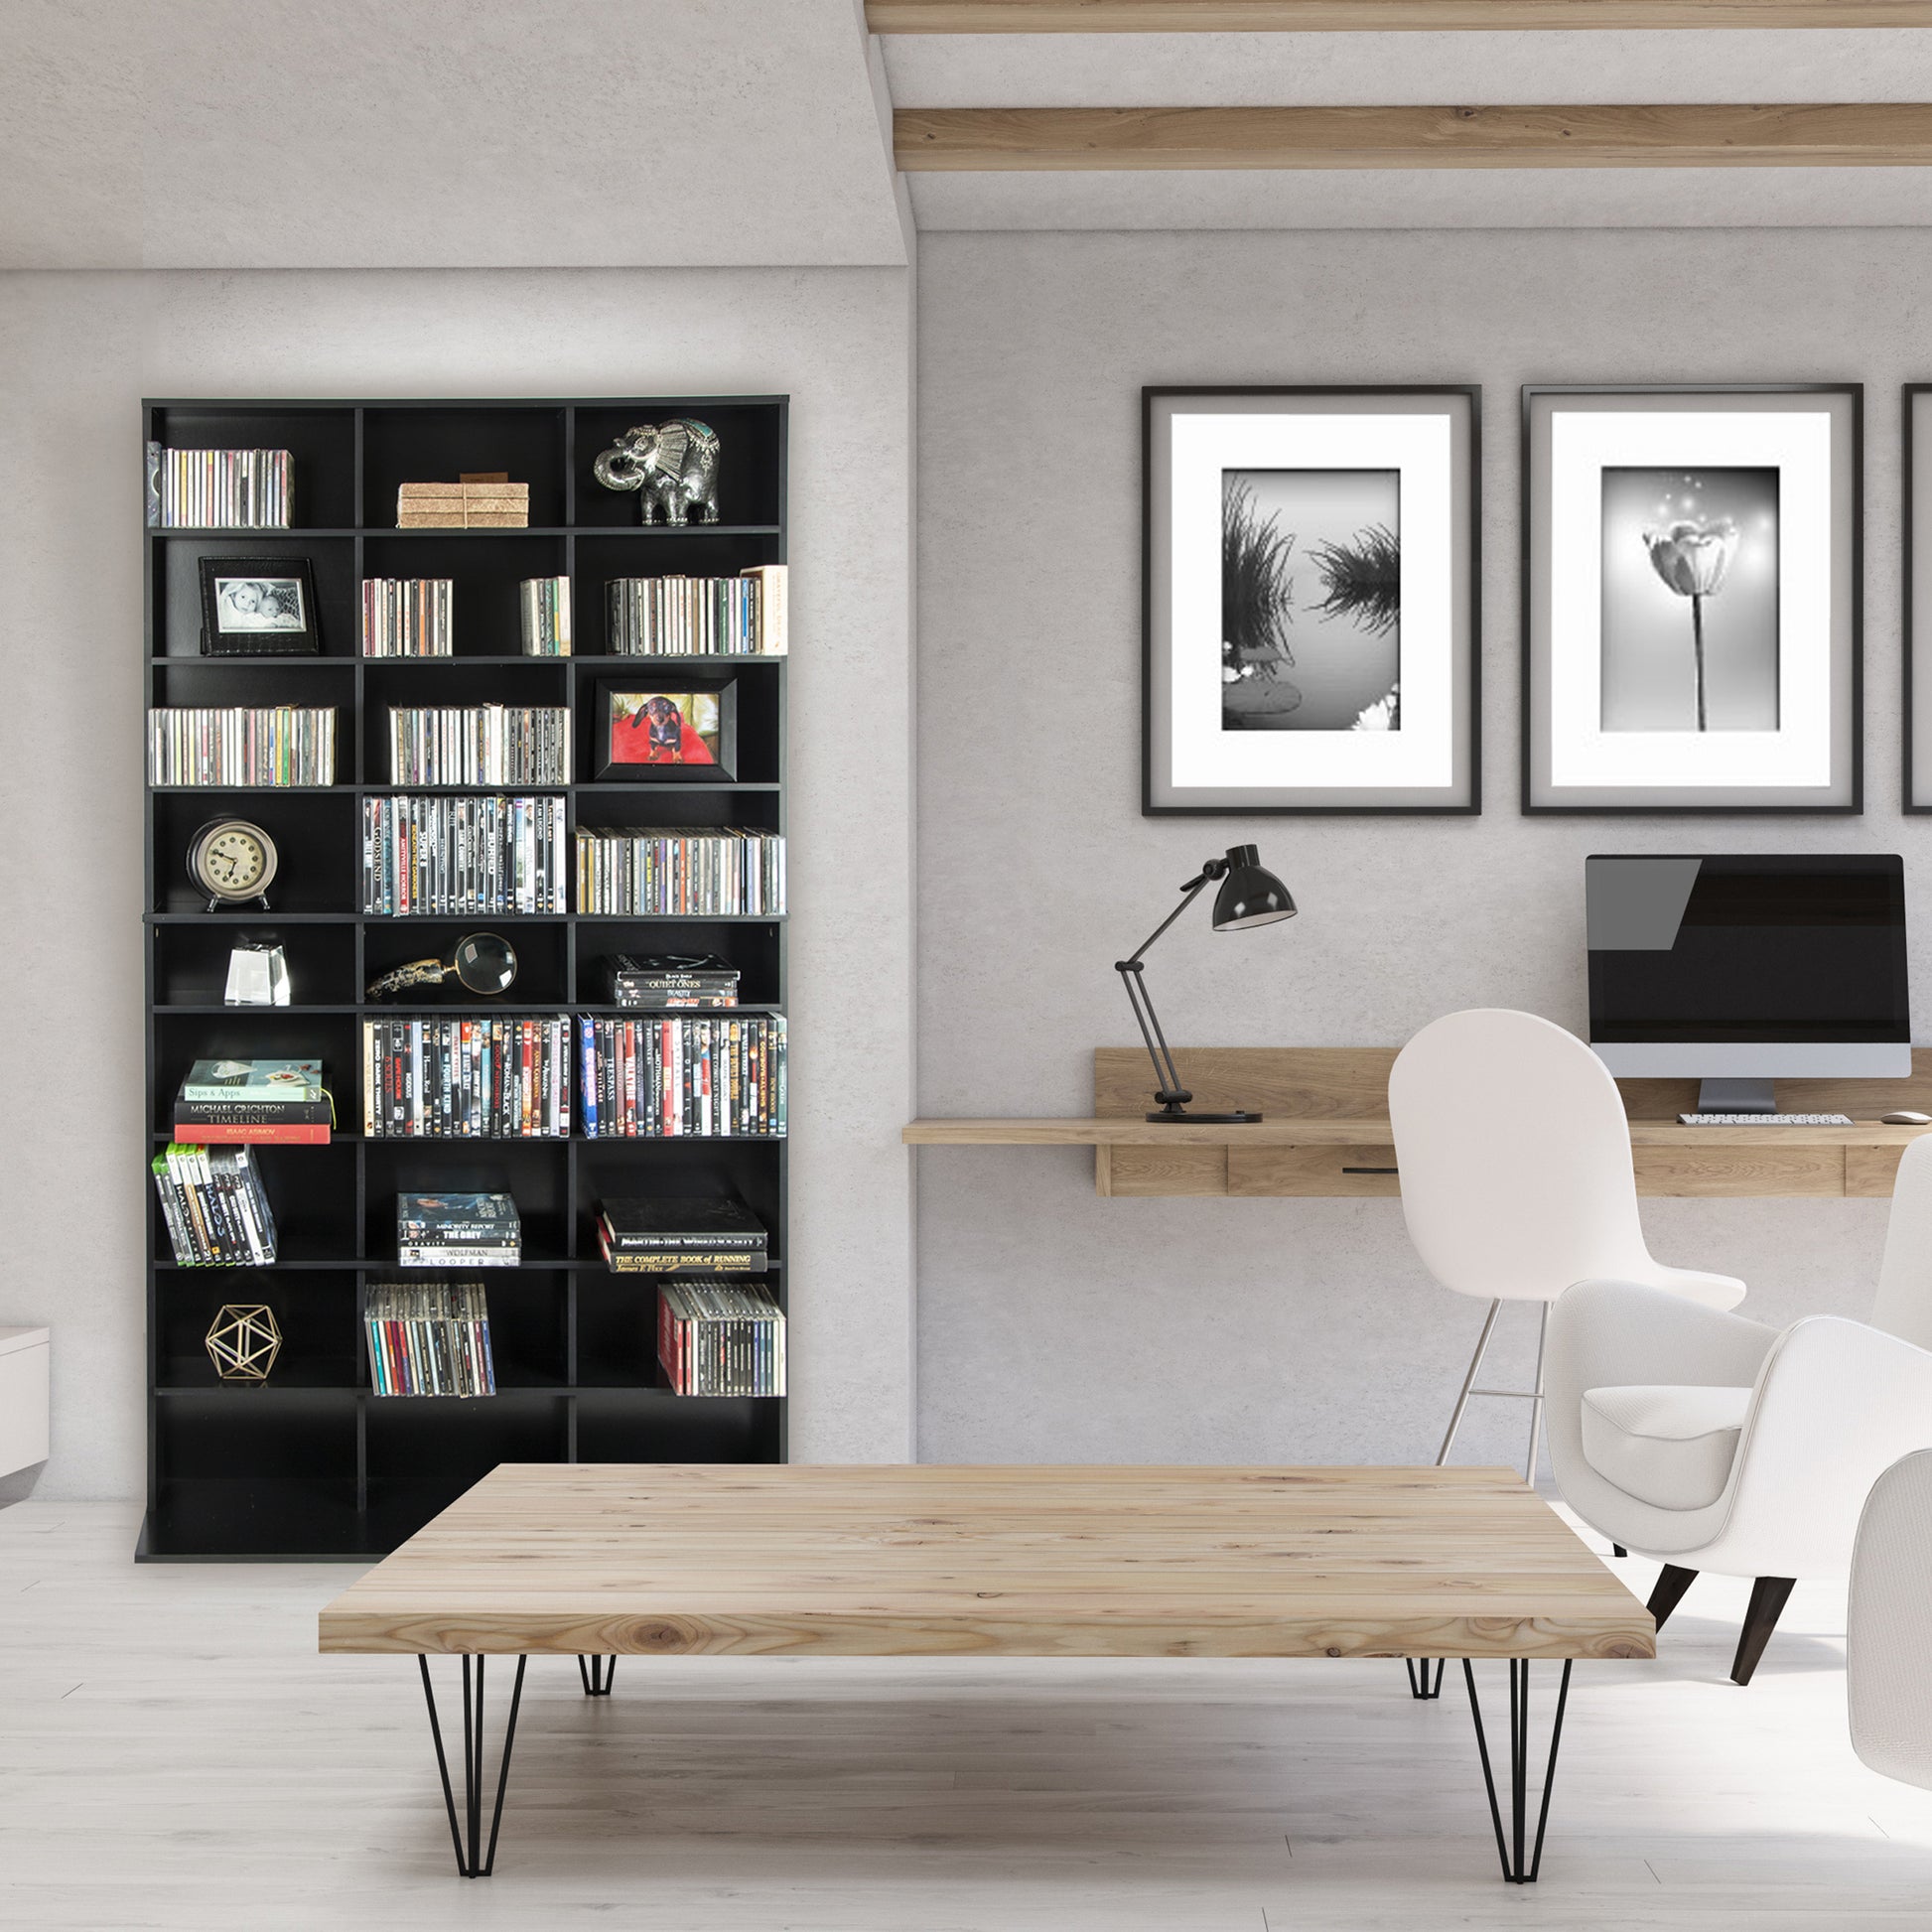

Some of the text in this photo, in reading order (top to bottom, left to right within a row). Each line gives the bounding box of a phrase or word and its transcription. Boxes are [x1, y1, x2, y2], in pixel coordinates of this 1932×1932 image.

[649, 980, 701, 989] QUIET ONES
[625, 1056, 635, 1100] VALKYRIE
[189, 1088, 207, 1099] Sips
[218, 1089, 241, 1100] Apps
[191, 1104, 285, 1114] MICHAEL CRICHTON
[502, 1092, 511, 1115] BLACK
[207, 1114, 268, 1124] TIMELINE
[176, 1185, 190, 1217] HALO
[206, 1184, 225, 1237] HALO 3
[634, 1255, 678, 1264] COMPLETE
[680, 1255, 703, 1264] BOOK
